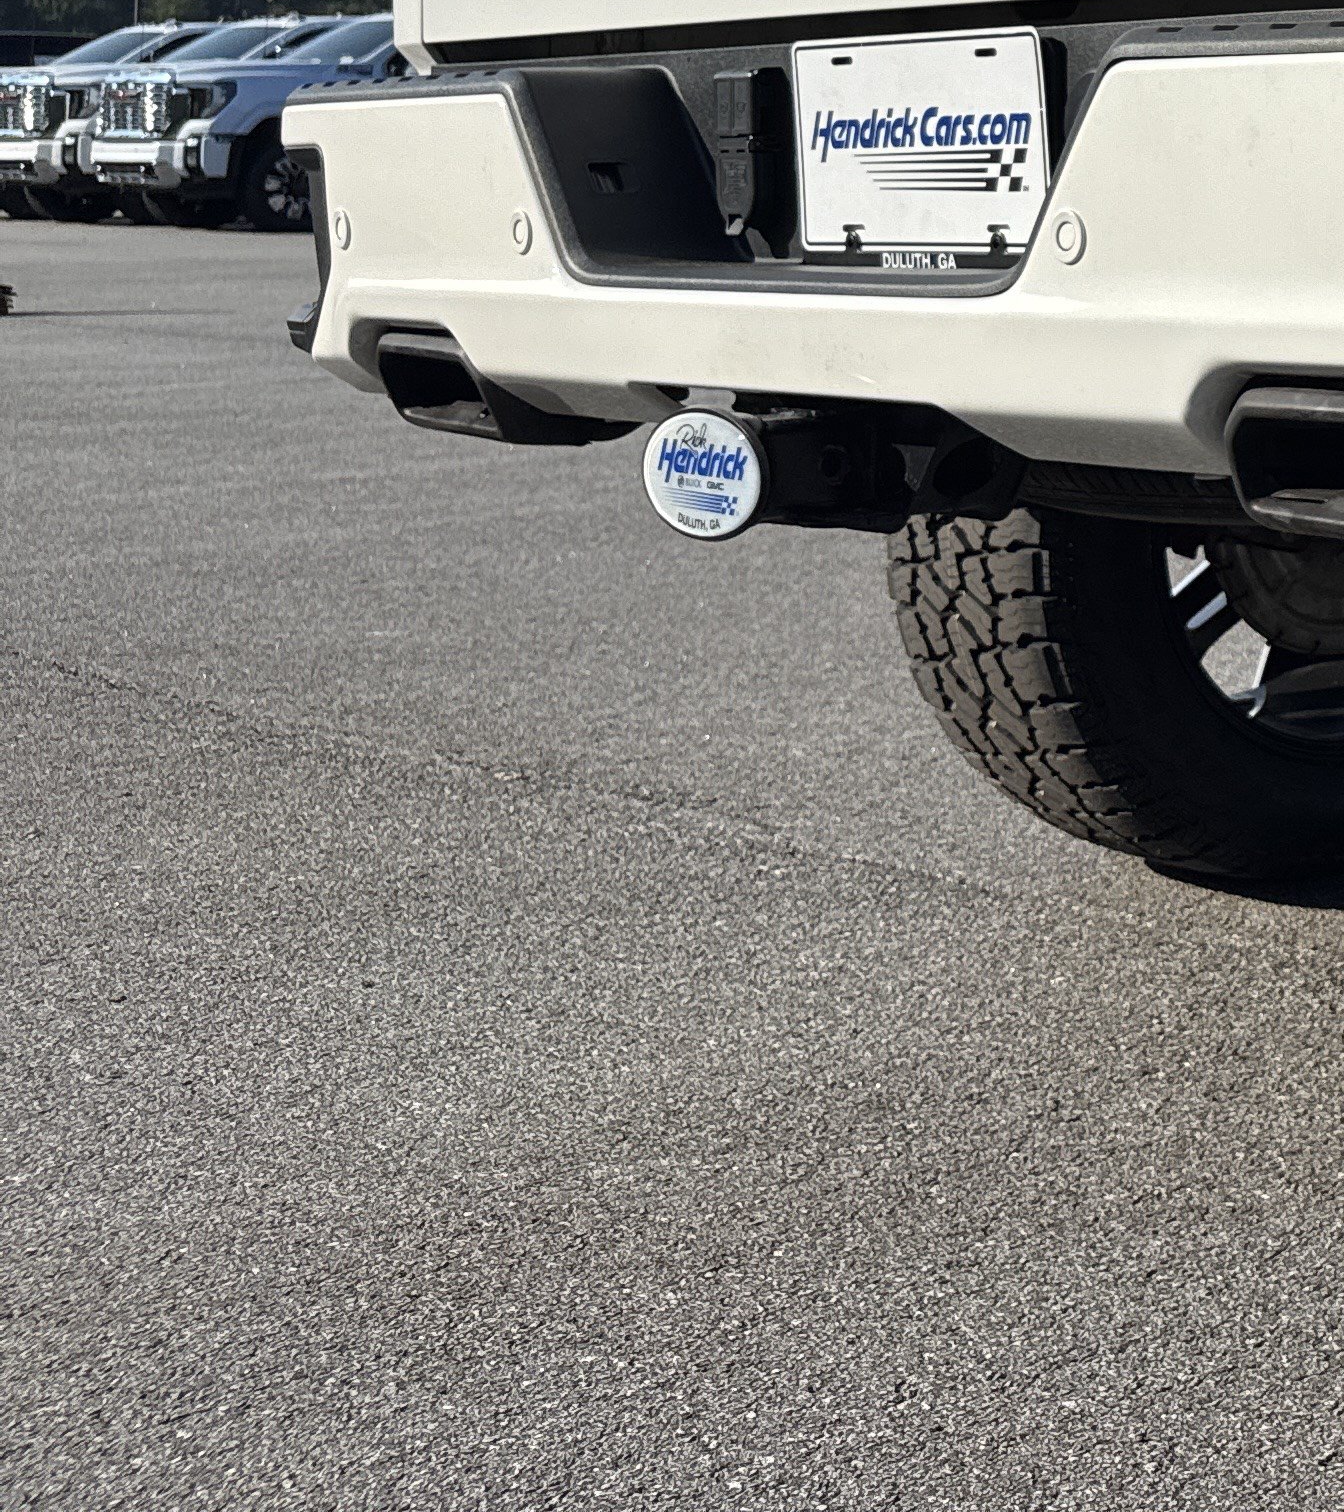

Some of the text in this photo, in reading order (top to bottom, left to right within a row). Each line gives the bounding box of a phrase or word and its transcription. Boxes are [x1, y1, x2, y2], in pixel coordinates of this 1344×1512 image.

[937, 253, 957, 269] GA
[657, 438, 748, 483] Hendrick
[709, 519, 721, 530] GA
